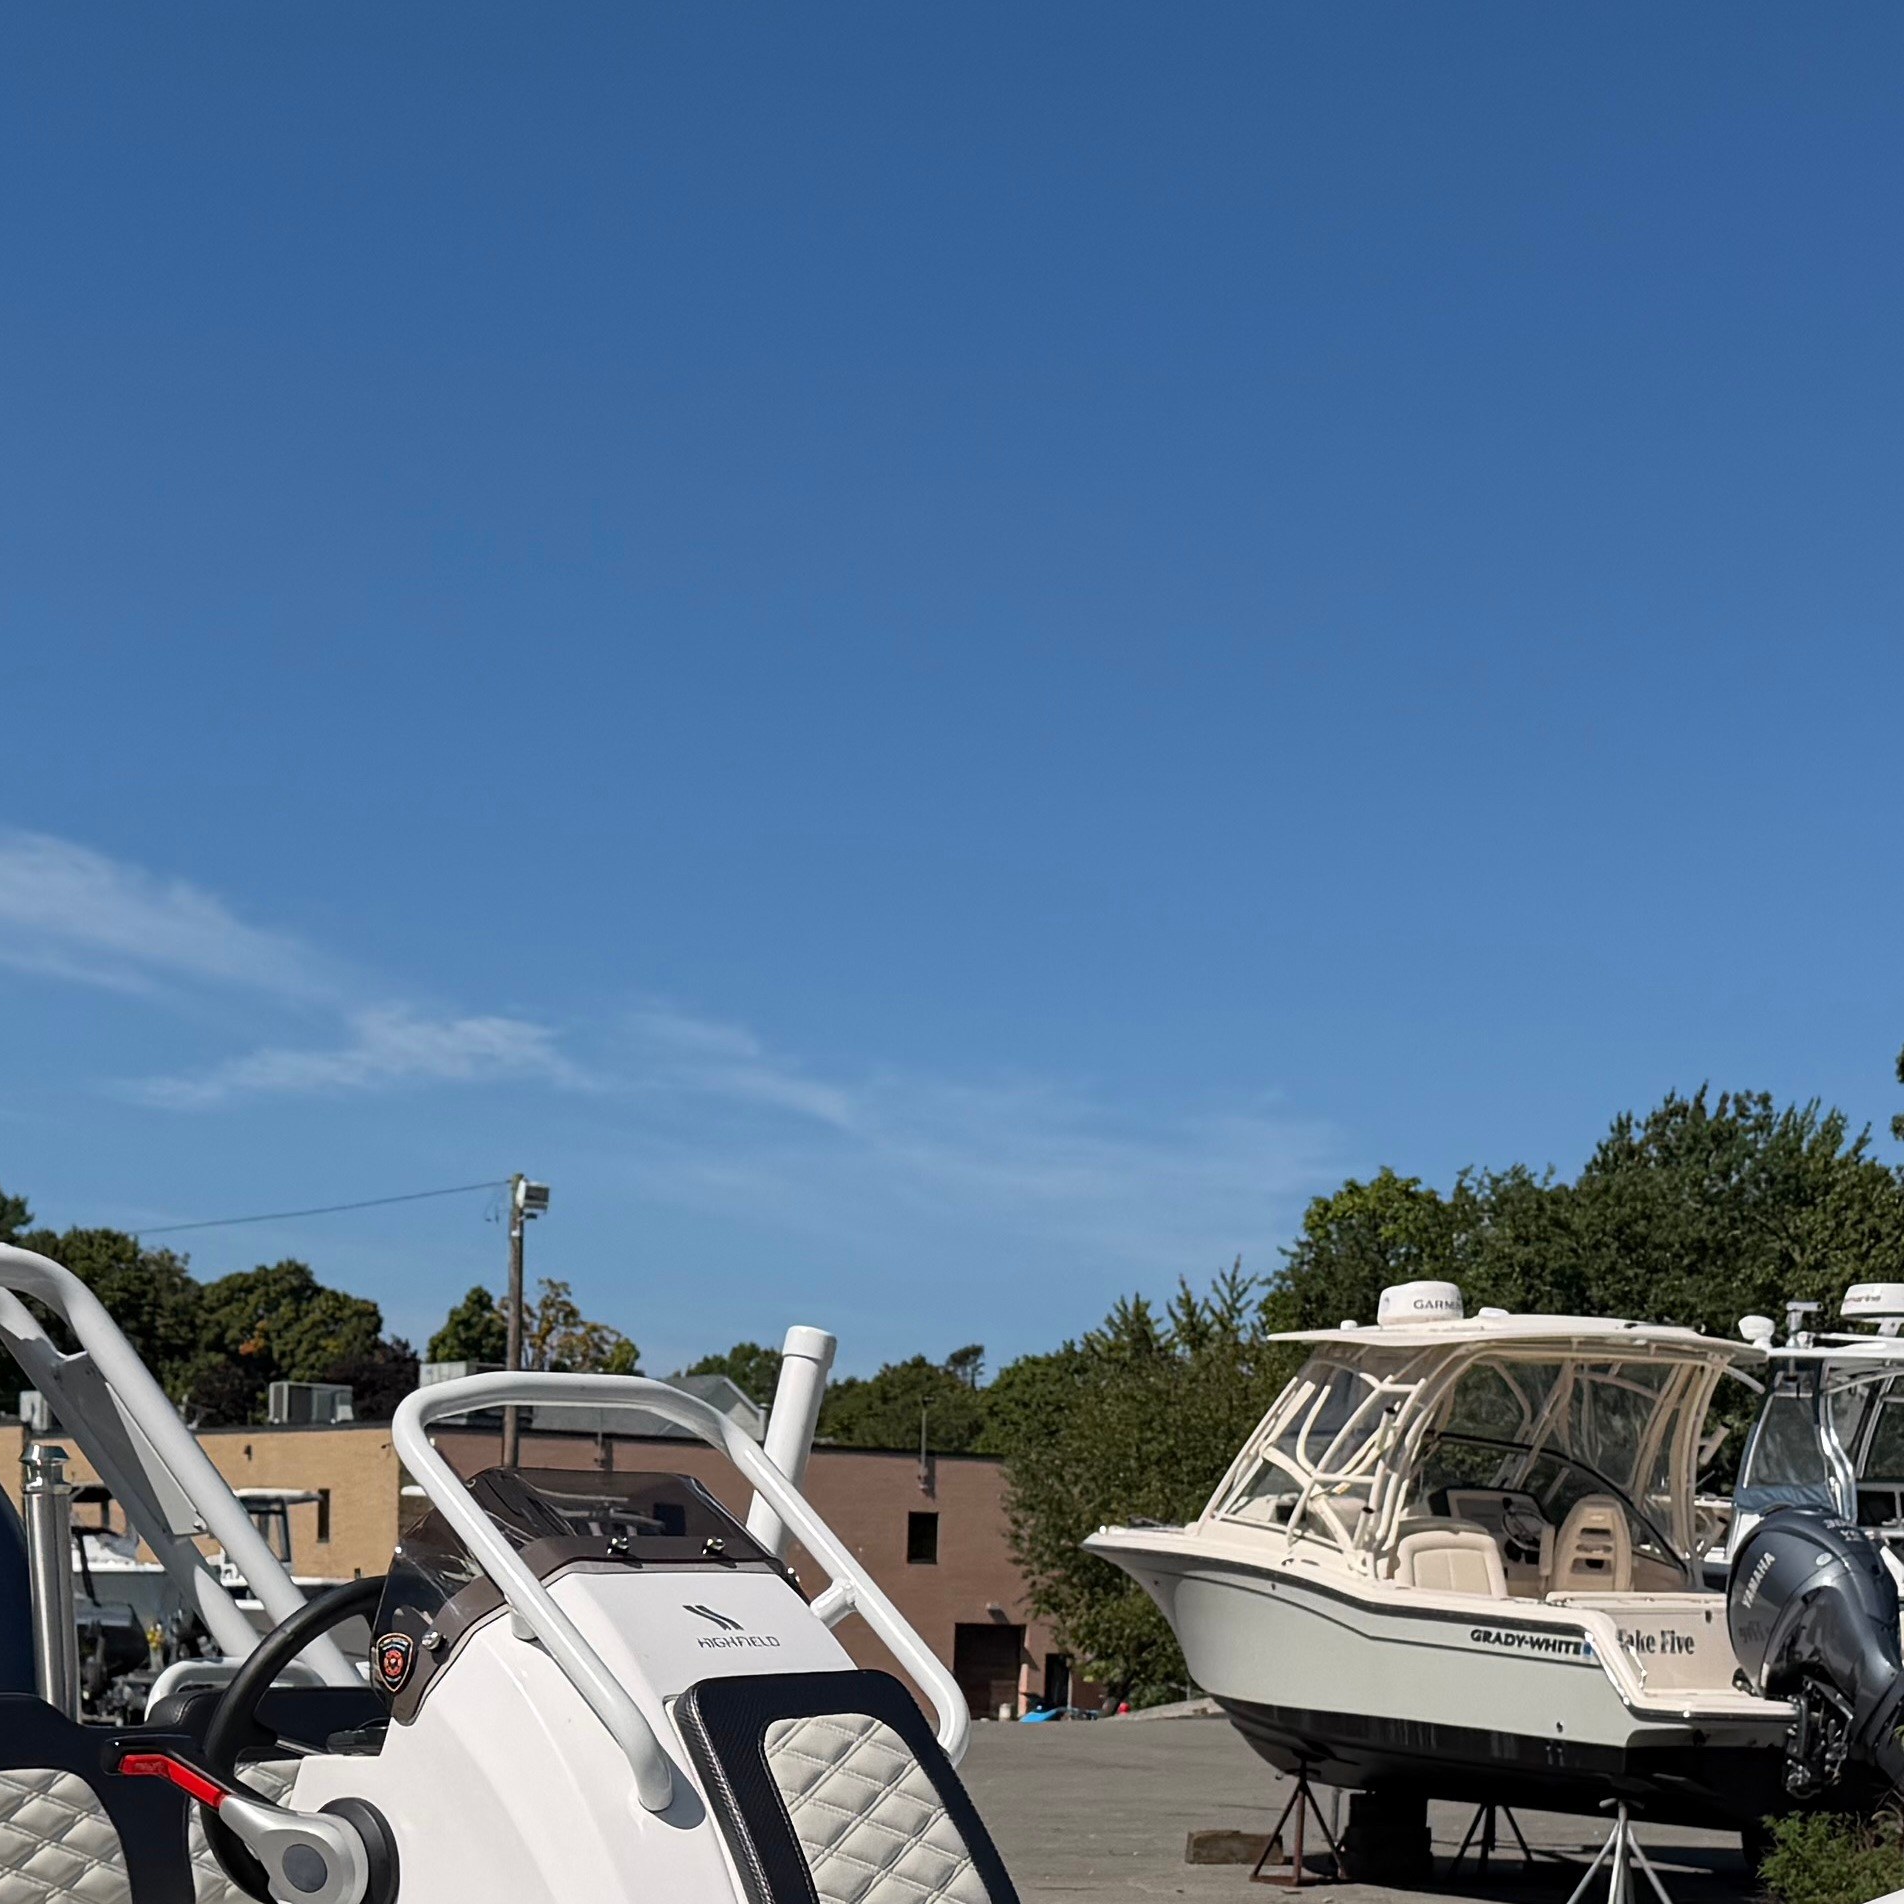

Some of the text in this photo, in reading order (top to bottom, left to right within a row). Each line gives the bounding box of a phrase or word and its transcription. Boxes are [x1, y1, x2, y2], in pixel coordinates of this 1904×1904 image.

[1741, 1552, 1776, 1608] YAMAHA
[696, 1636, 781, 1648] HIGHFIELD
[1470, 1629, 1582, 1655] GRADY-WHITE
[1660, 1629, 1695, 1655] Five
